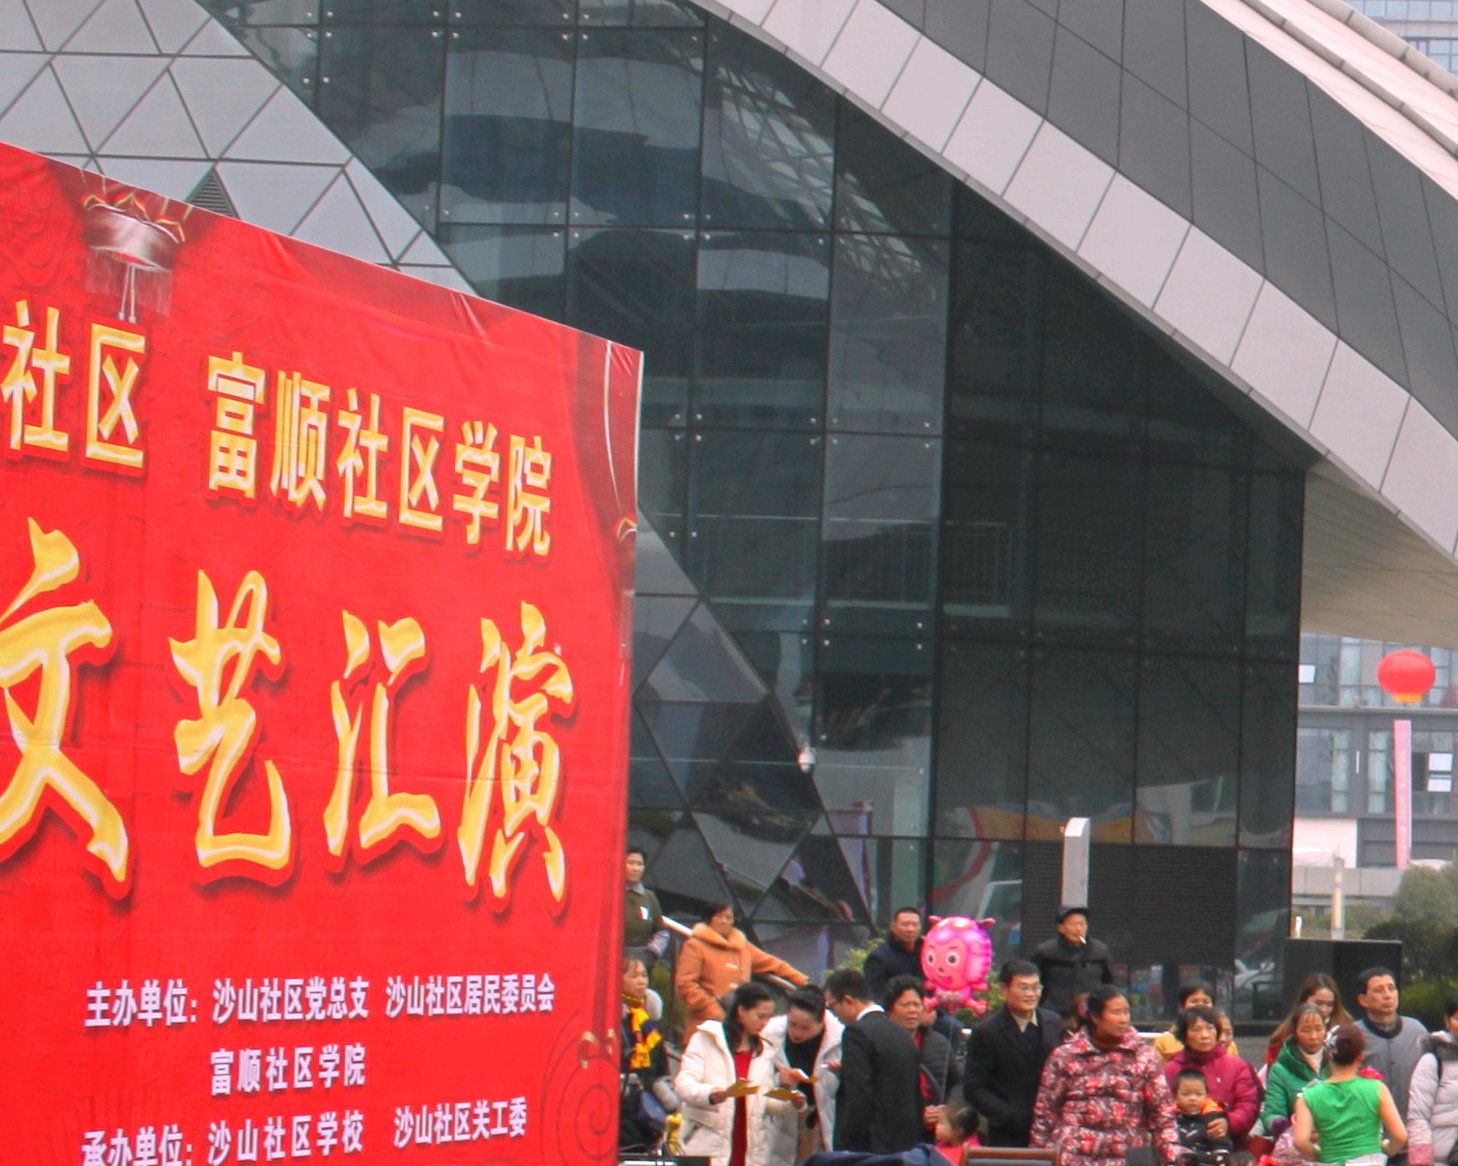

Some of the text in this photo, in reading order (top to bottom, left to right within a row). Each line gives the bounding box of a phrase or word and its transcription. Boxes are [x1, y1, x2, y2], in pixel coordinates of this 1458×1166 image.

[1, 301, 552, 556] 社区 富顺社区学院
[0, 518, 573, 900] 文艺汇演
[213, 976, 370, 1023] 沙山社区党总支
[386, 974, 555, 1017] 沙山社区居民委员会
[211, 1043, 366, 1096] 富顺社区学院
[209, 1110, 364, 1166] 沙山社区学校
[395, 1097, 527, 1147] 沙山社区关工委
